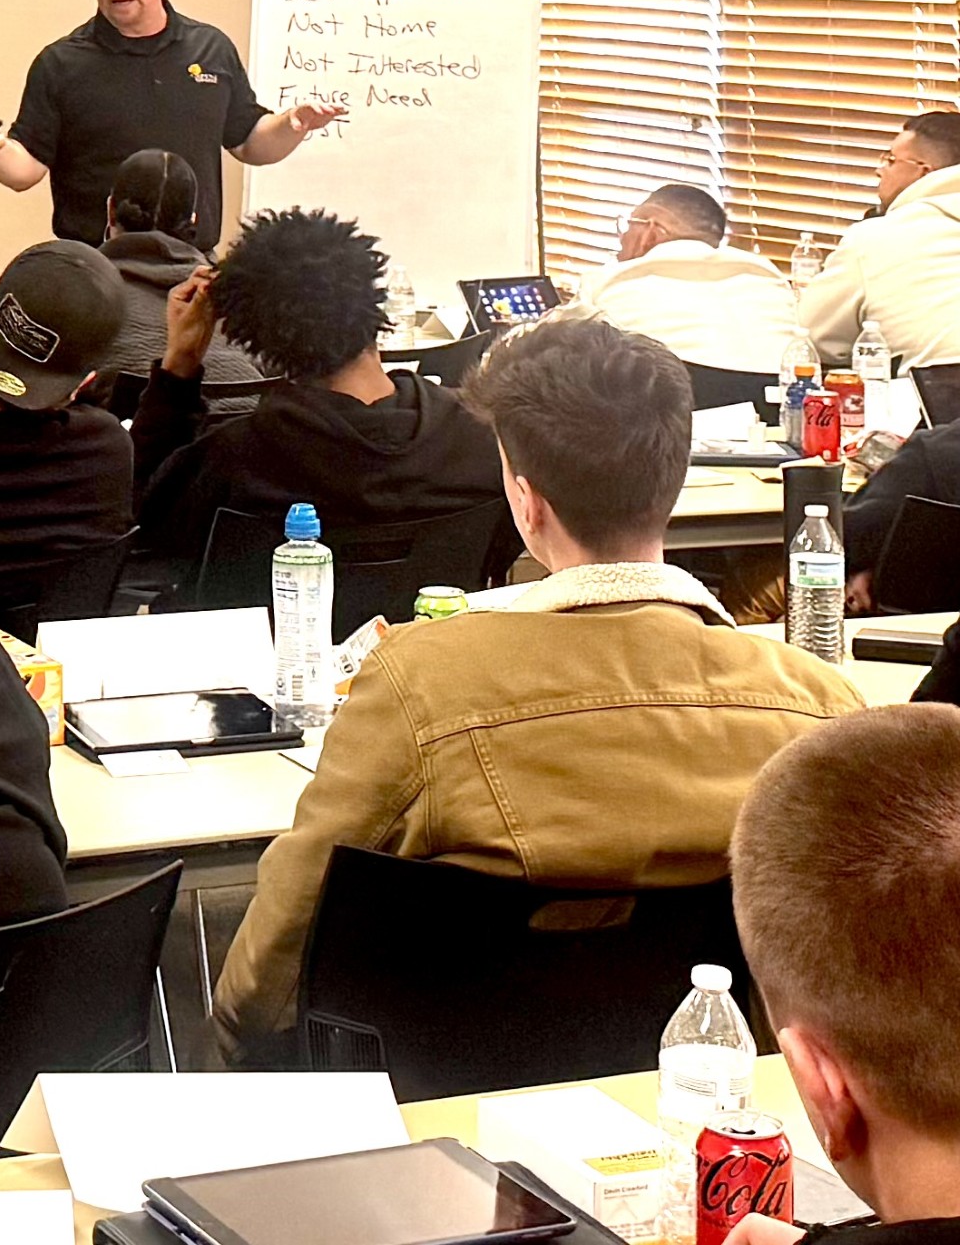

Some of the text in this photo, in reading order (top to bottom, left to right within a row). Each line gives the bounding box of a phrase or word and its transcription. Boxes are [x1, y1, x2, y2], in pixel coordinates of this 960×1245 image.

[287, 12, 438, 38] Not Home
[283, 46, 483, 80] Not Interested
[366, 84, 433, 108] Need
